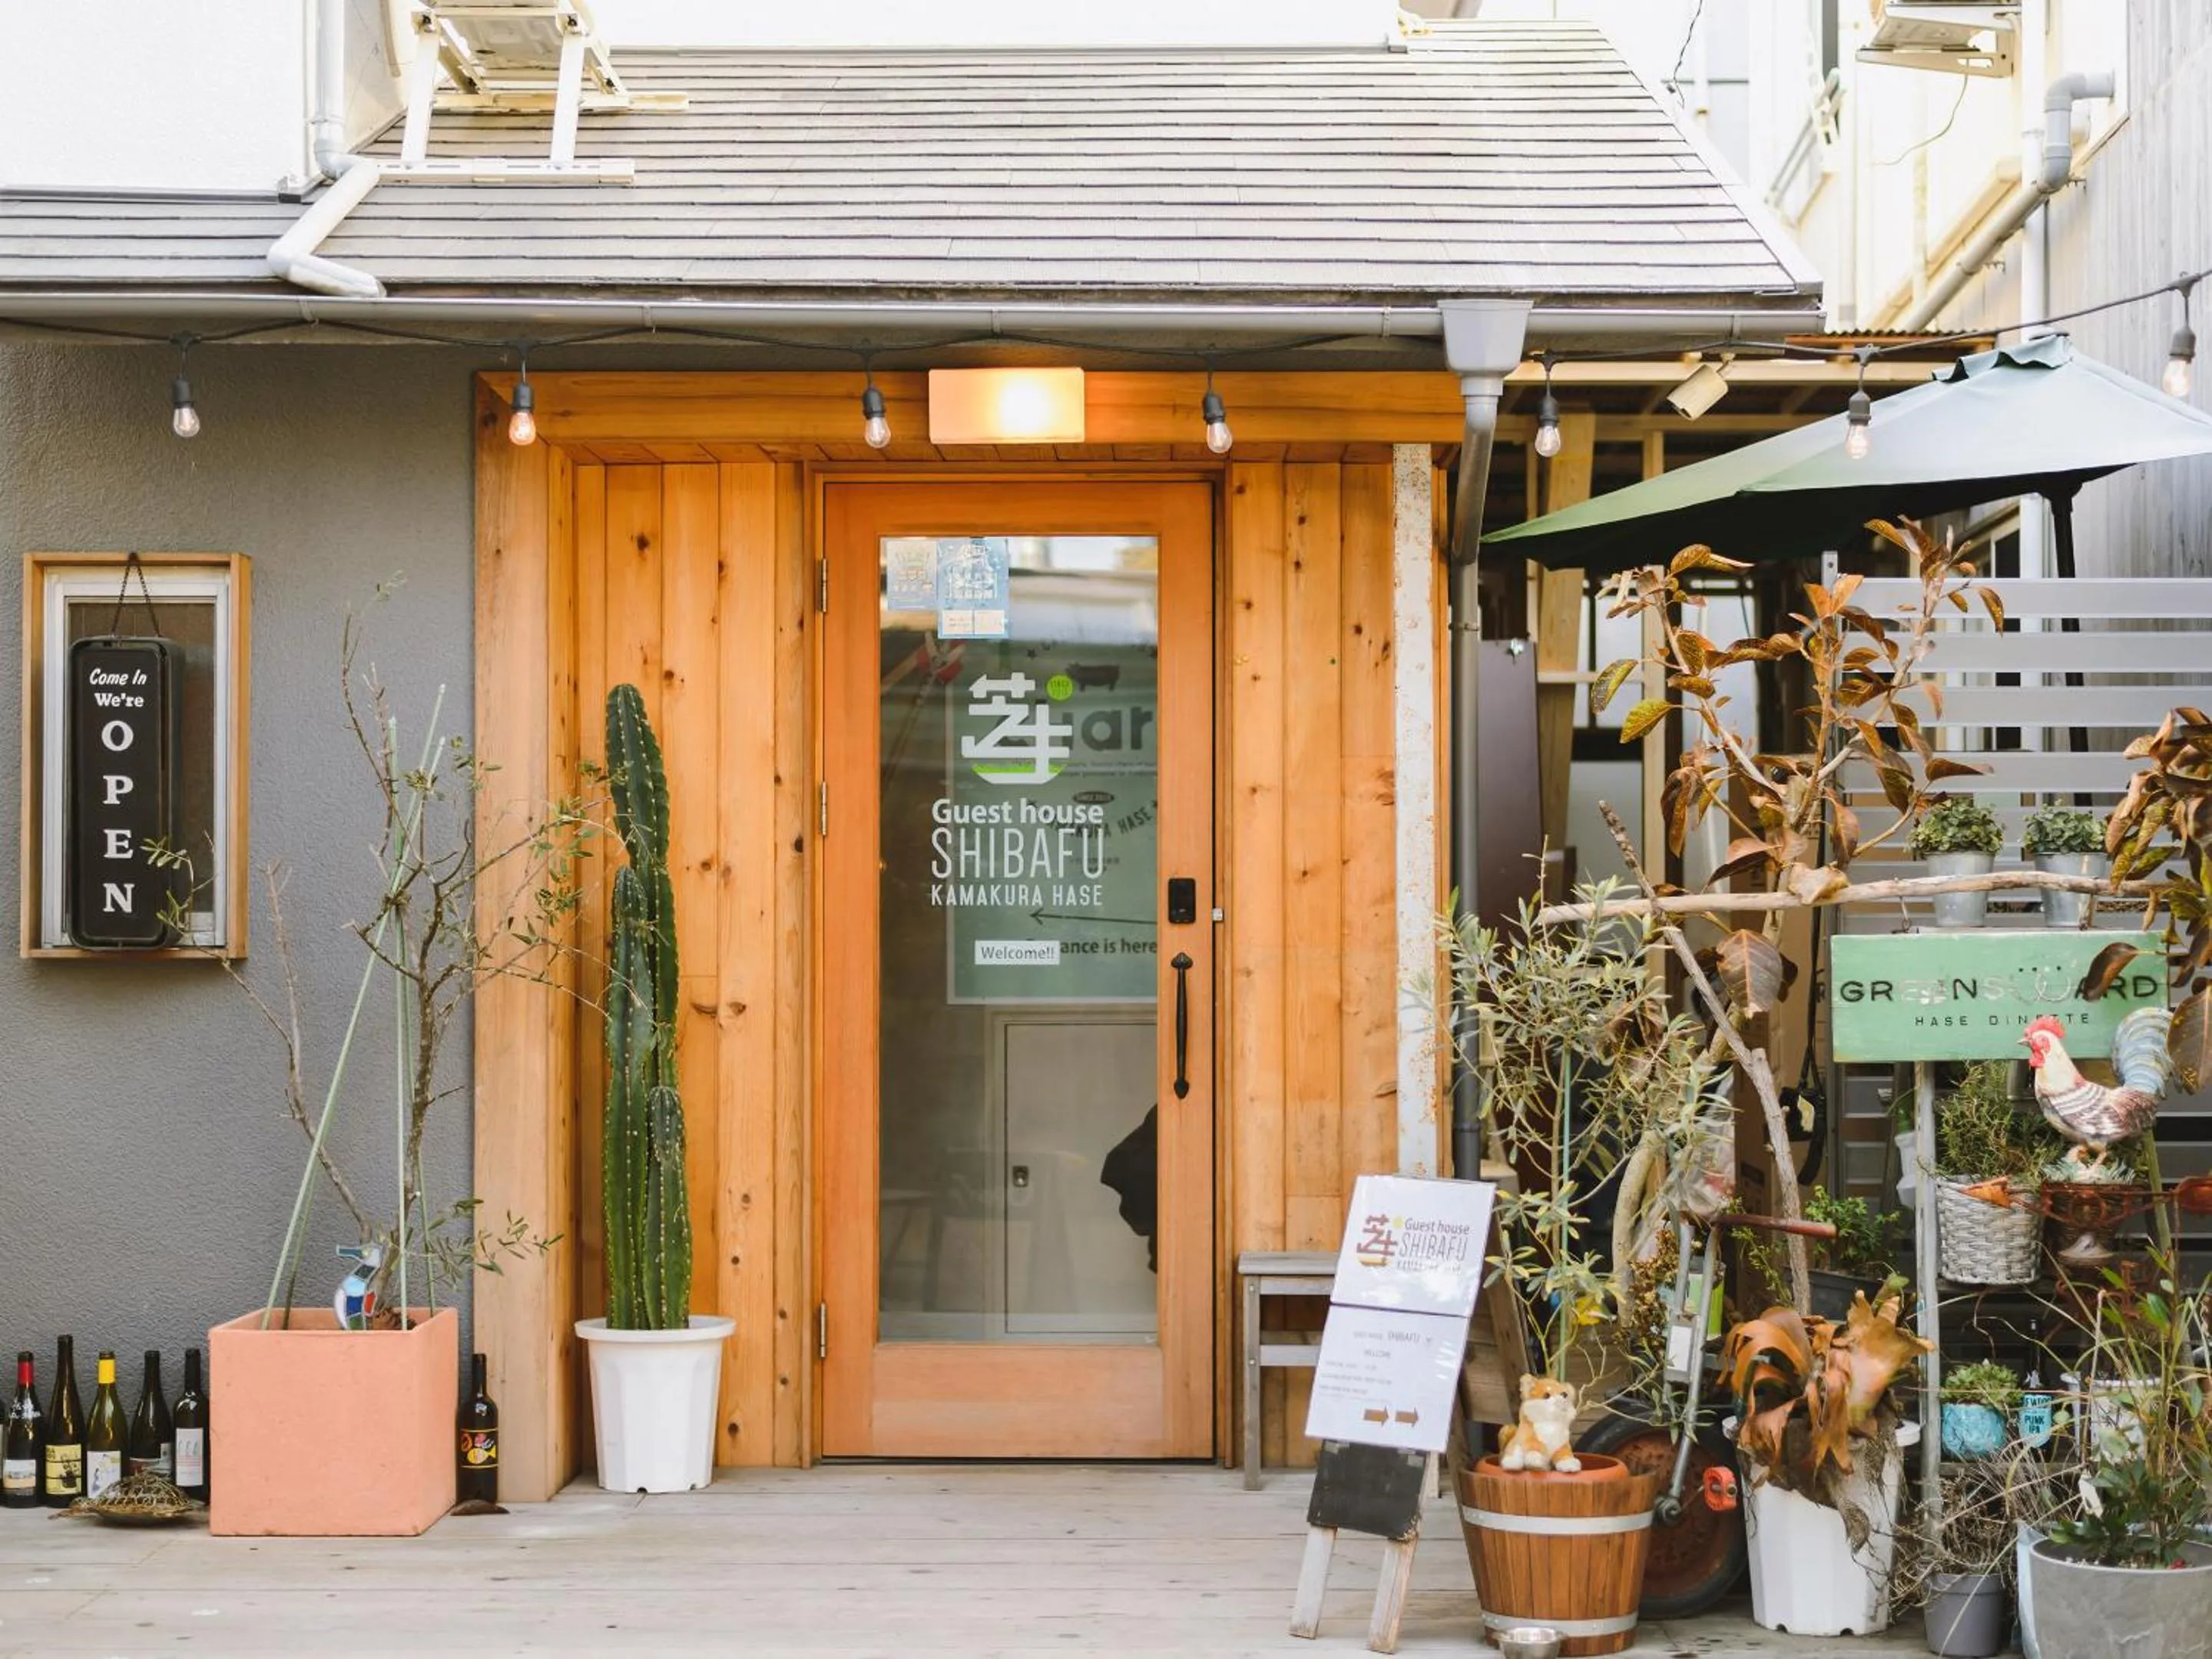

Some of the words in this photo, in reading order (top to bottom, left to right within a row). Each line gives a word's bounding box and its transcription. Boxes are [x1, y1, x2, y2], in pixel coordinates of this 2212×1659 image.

[90, 667, 128, 685] Come
[132, 668, 147, 685] In
[94, 692, 144, 707] We're
[101, 720, 134, 913] OPEN
[932, 799, 1012, 824] Guest
[1020, 798, 1104, 824] house
[931, 827, 1104, 879] SHIBAFU
[931, 884, 1043, 906] KAMAKURA
[1052, 884, 1104, 906] HASE
[981, 945, 1055, 960] Welcome!!
[1104, 939, 1117, 954] is
[1915, 1015, 1969, 1027] HASE
[1989, 1012, 2089, 1027] DINTE
[1405, 1217, 1435, 1232] Guest
[1438, 1220, 1470, 1235] house
[1399, 1232, 1469, 1262] SHIBAFU
